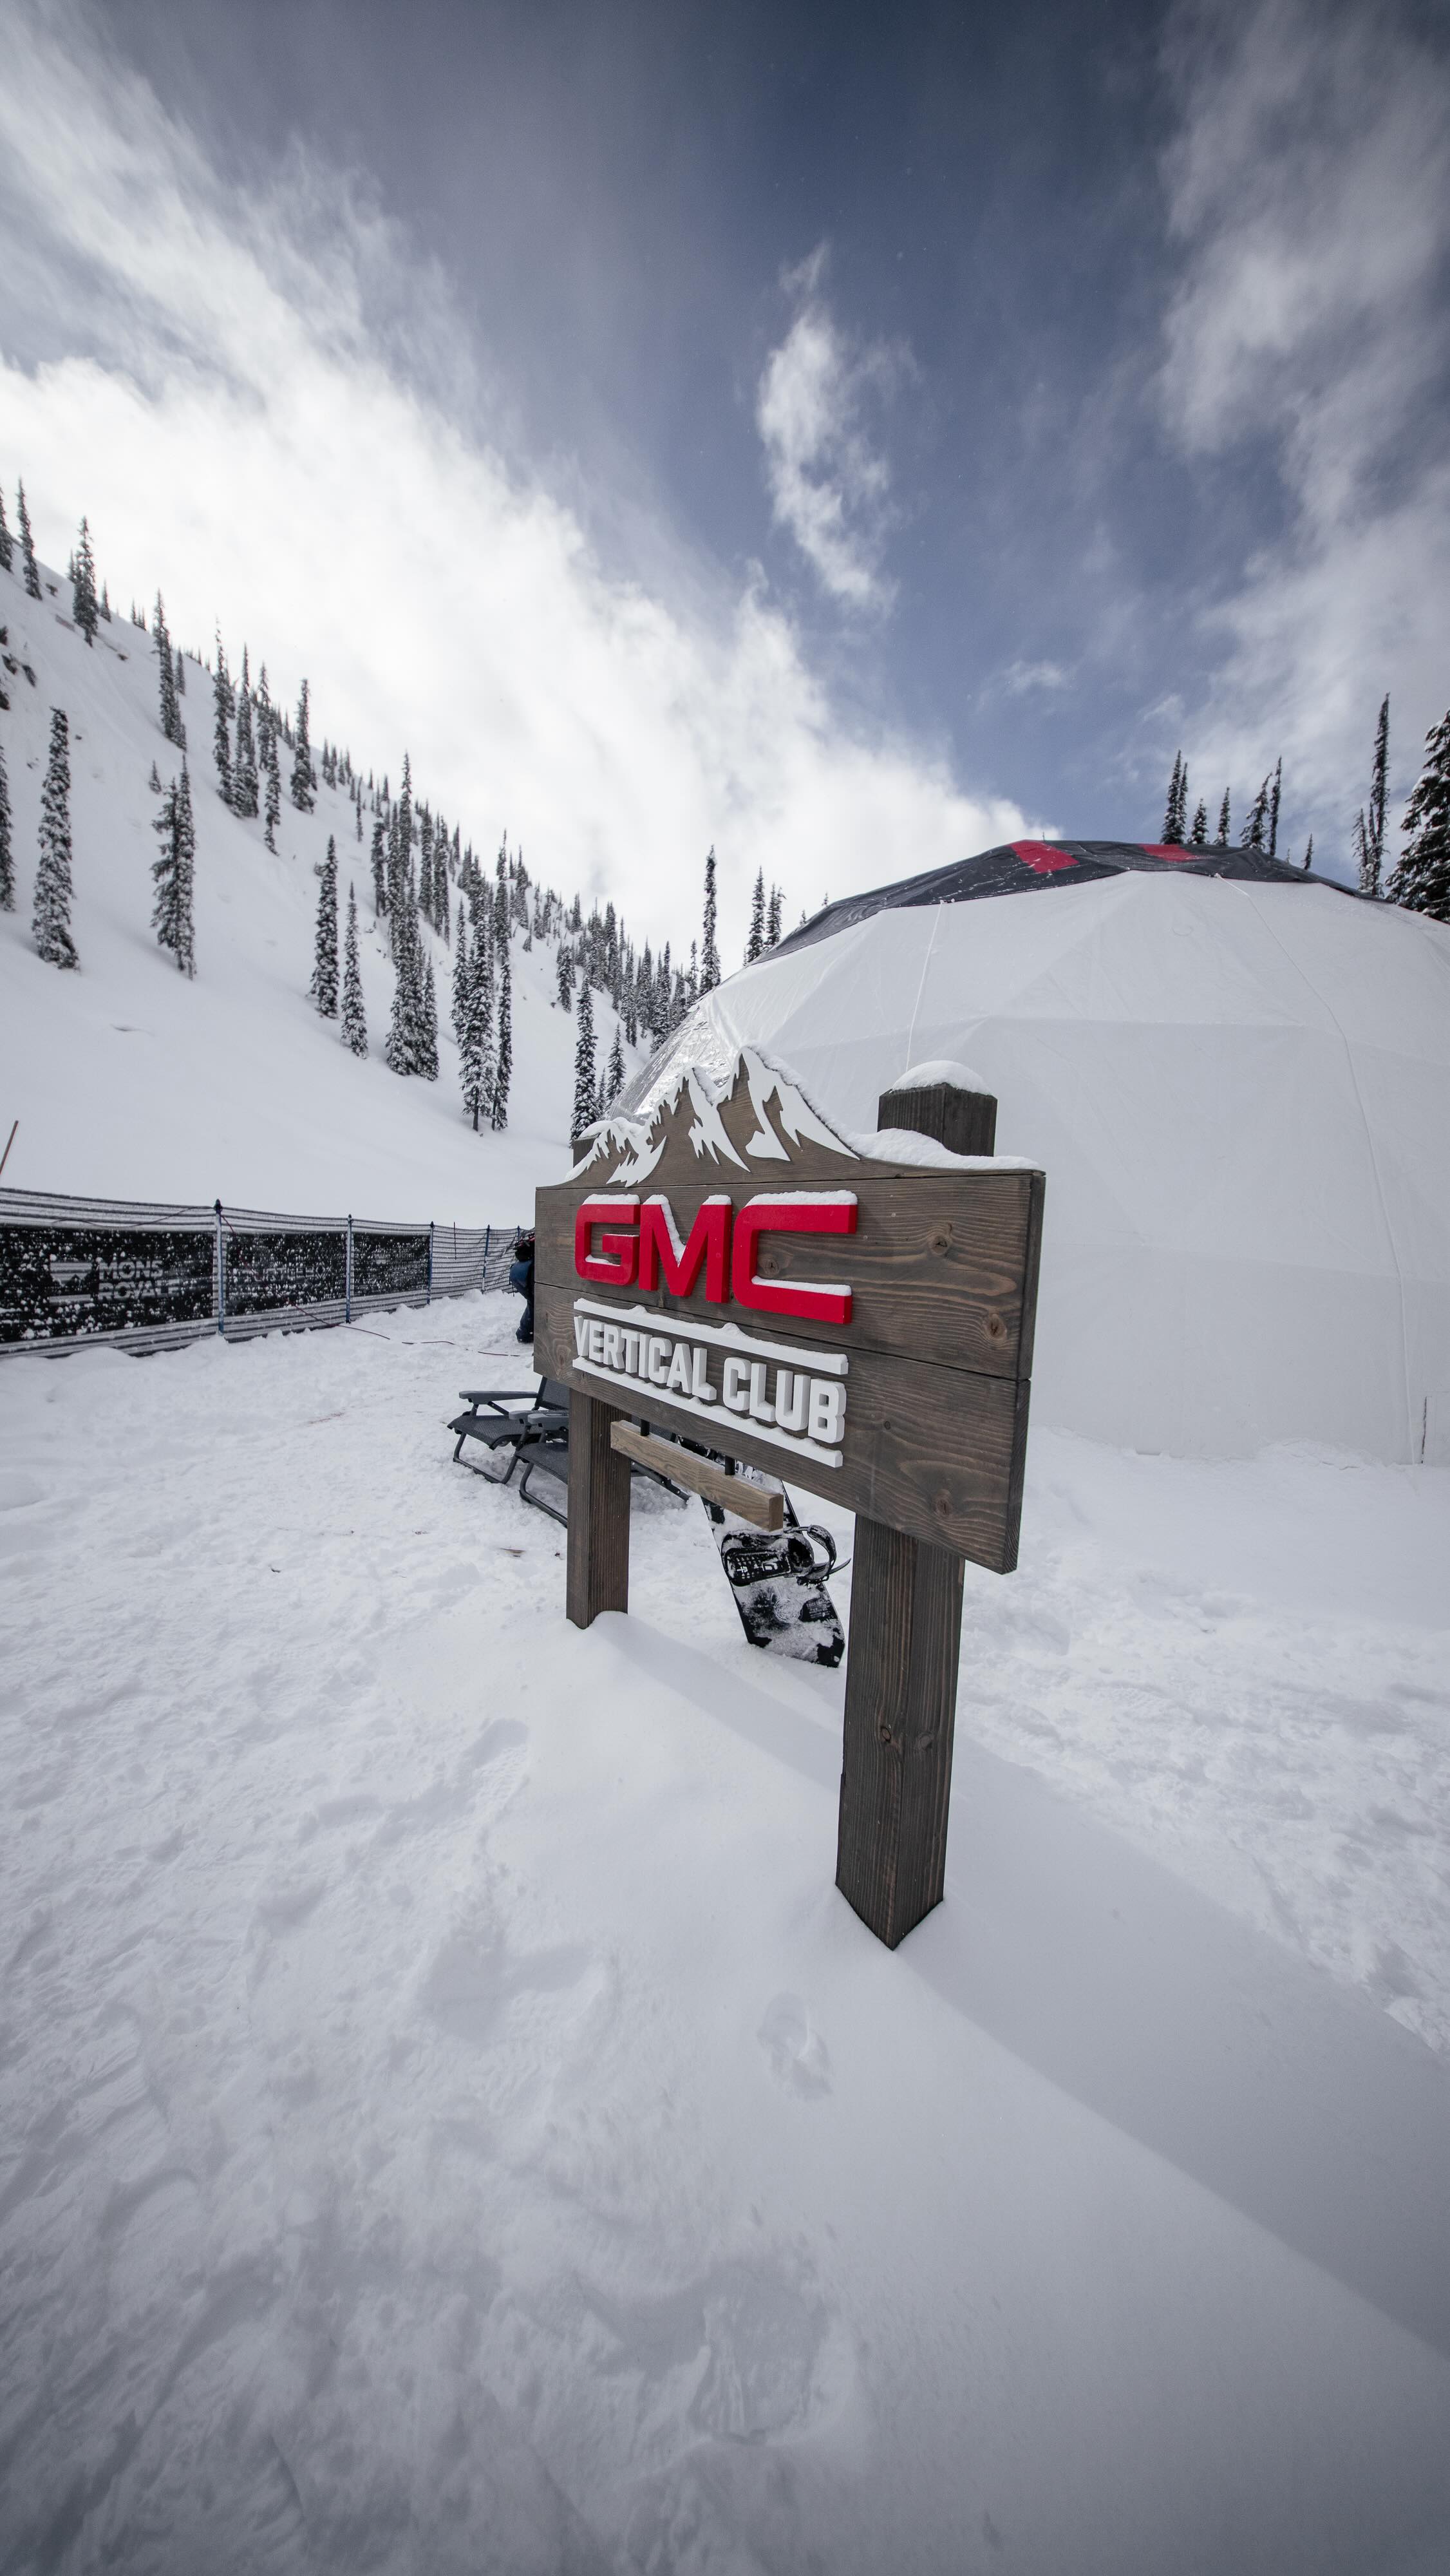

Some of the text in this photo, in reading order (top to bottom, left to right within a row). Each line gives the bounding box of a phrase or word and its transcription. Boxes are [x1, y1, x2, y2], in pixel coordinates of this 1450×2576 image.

[98, 1281, 180, 1300] ROYALE
[99, 1260, 163, 1280] MONS
[575, 1203, 857, 1324] GMC
[574, 1316, 847, 1443] VERTICAL CLUB
